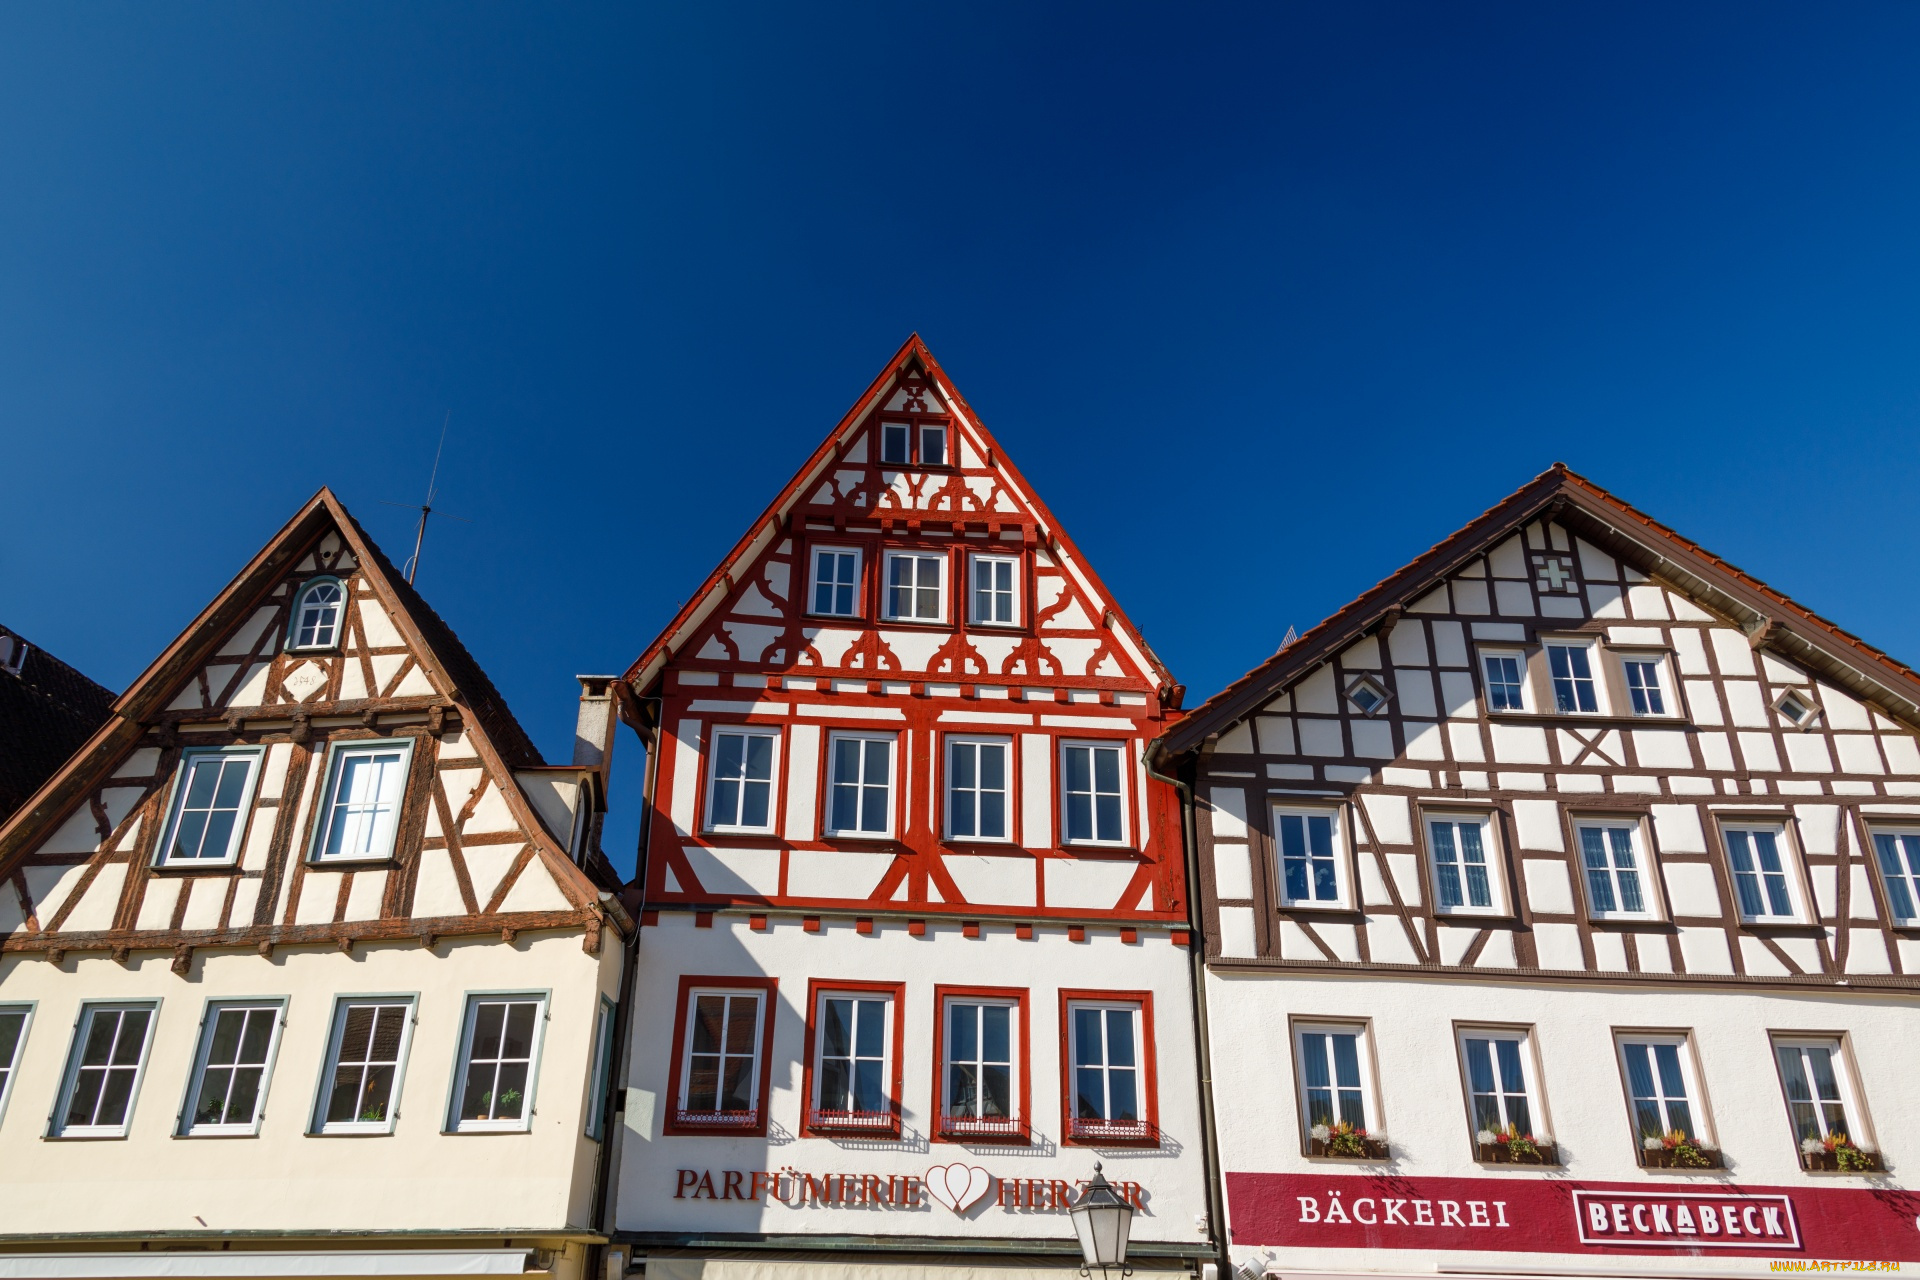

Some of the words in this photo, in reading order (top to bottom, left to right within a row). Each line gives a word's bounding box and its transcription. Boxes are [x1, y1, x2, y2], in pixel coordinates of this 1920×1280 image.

[673, 1166, 921, 1205] PARFÜMERIE
[996, 1178, 1146, 1210] HERZR
[1297, 1190, 1510, 1227] BÄCKEREI
[1589, 1203, 1784, 1235] BECKABECK
